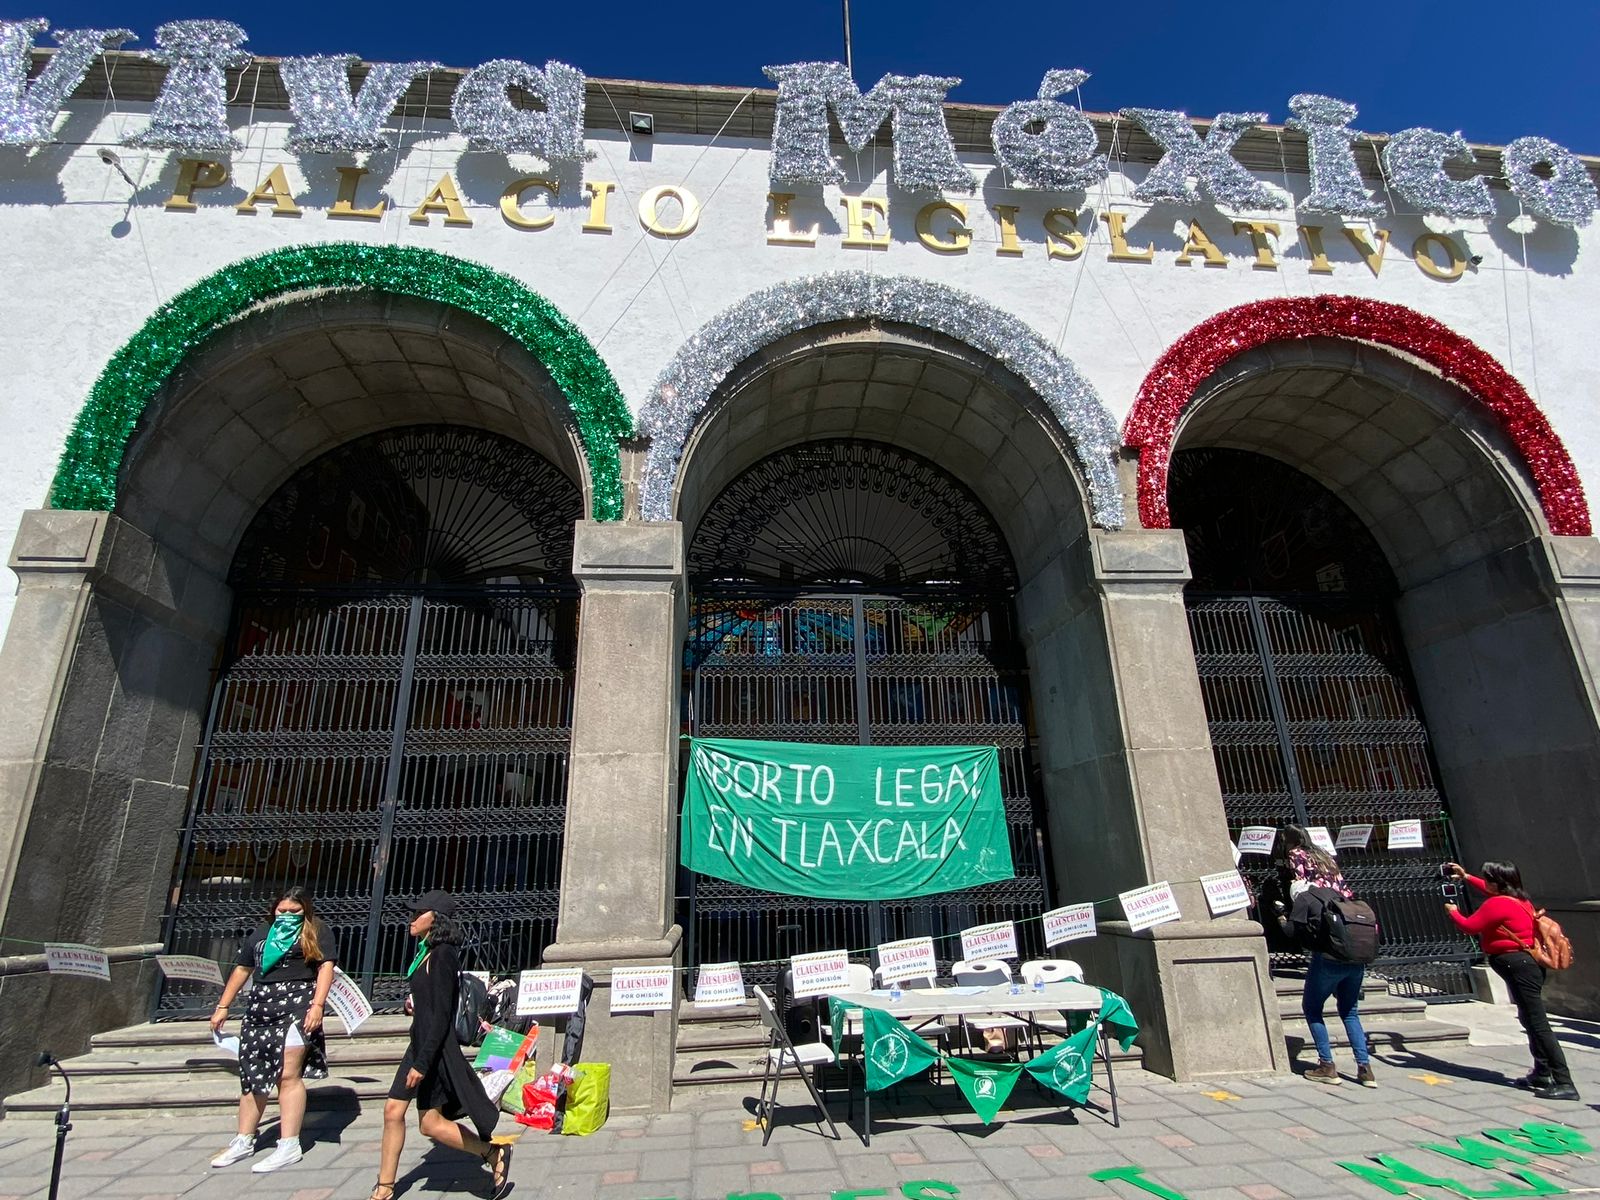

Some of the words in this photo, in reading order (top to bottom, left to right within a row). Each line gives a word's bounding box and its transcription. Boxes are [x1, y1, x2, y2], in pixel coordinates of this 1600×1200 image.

[164, 159, 700, 238] PALACIO
[767, 192, 1469, 280] LEGISLATIVO
[696, 747, 835, 805] ABORTO
[875, 761, 982, 807] LEGAL
[708, 804, 754, 858] EN
[771, 816, 967, 868] TLAXCALA
[1126, 891, 1170, 912] CLAUSURADO
[1046, 911, 1091, 930] CLAUSURADO
[1134, 912, 1147, 920] POR
[1063, 923, 1089, 932] OMISIÓN
[965, 931, 1011, 949] CLAUSURADO
[882, 947, 930, 964] CLAUSURADO
[971, 948, 983, 956] POR
[983, 943, 1009, 953] OMISIÓN
[795, 960, 845, 977] CLAUSURADO
[889, 965, 902, 973] POR
[902, 960, 928, 971] OMISIÓN
[523, 978, 577, 993] CLAUSURADO
[615, 976, 669, 990] CLAUSURADO
[802, 978, 815, 986] POR
[815, 975, 842, 985] OMISIÓN
[635, 991, 664, 999] OMISIÓN
[713, 986, 738, 995] OMISIÓN
[542, 994, 571, 1002] OMISIÓN
